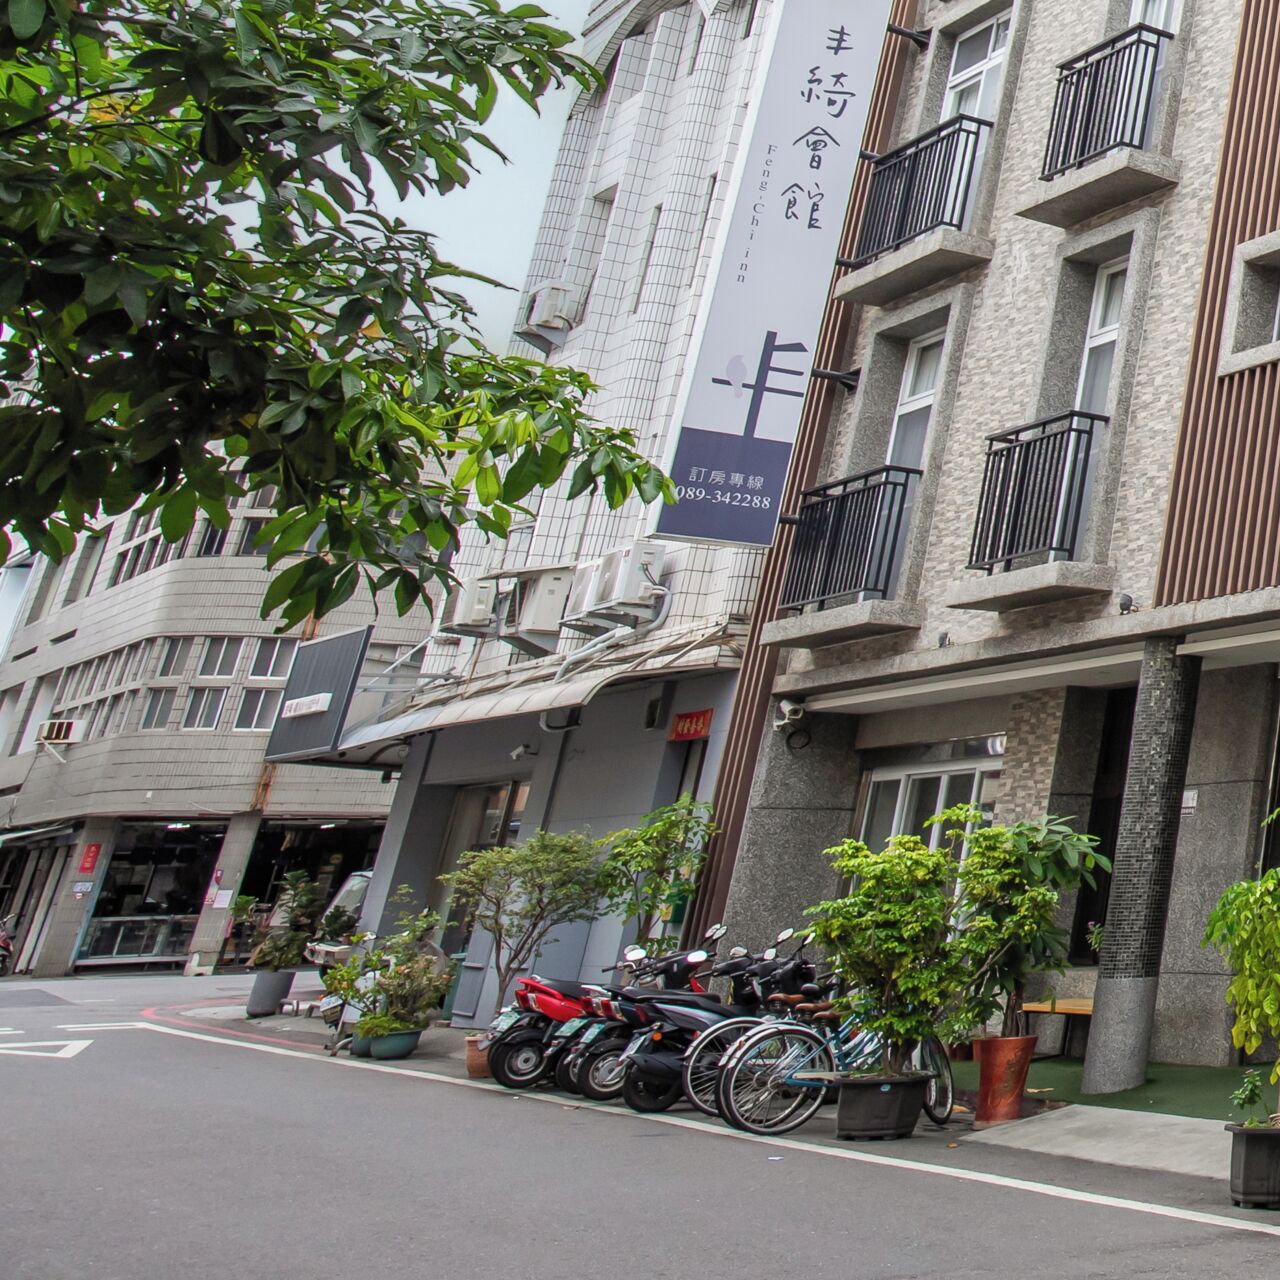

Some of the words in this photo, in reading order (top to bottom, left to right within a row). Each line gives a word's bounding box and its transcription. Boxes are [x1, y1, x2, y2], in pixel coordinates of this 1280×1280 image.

[688, 466, 765, 491] 訂房專線
[675, 485, 771, 510] 089-342288
